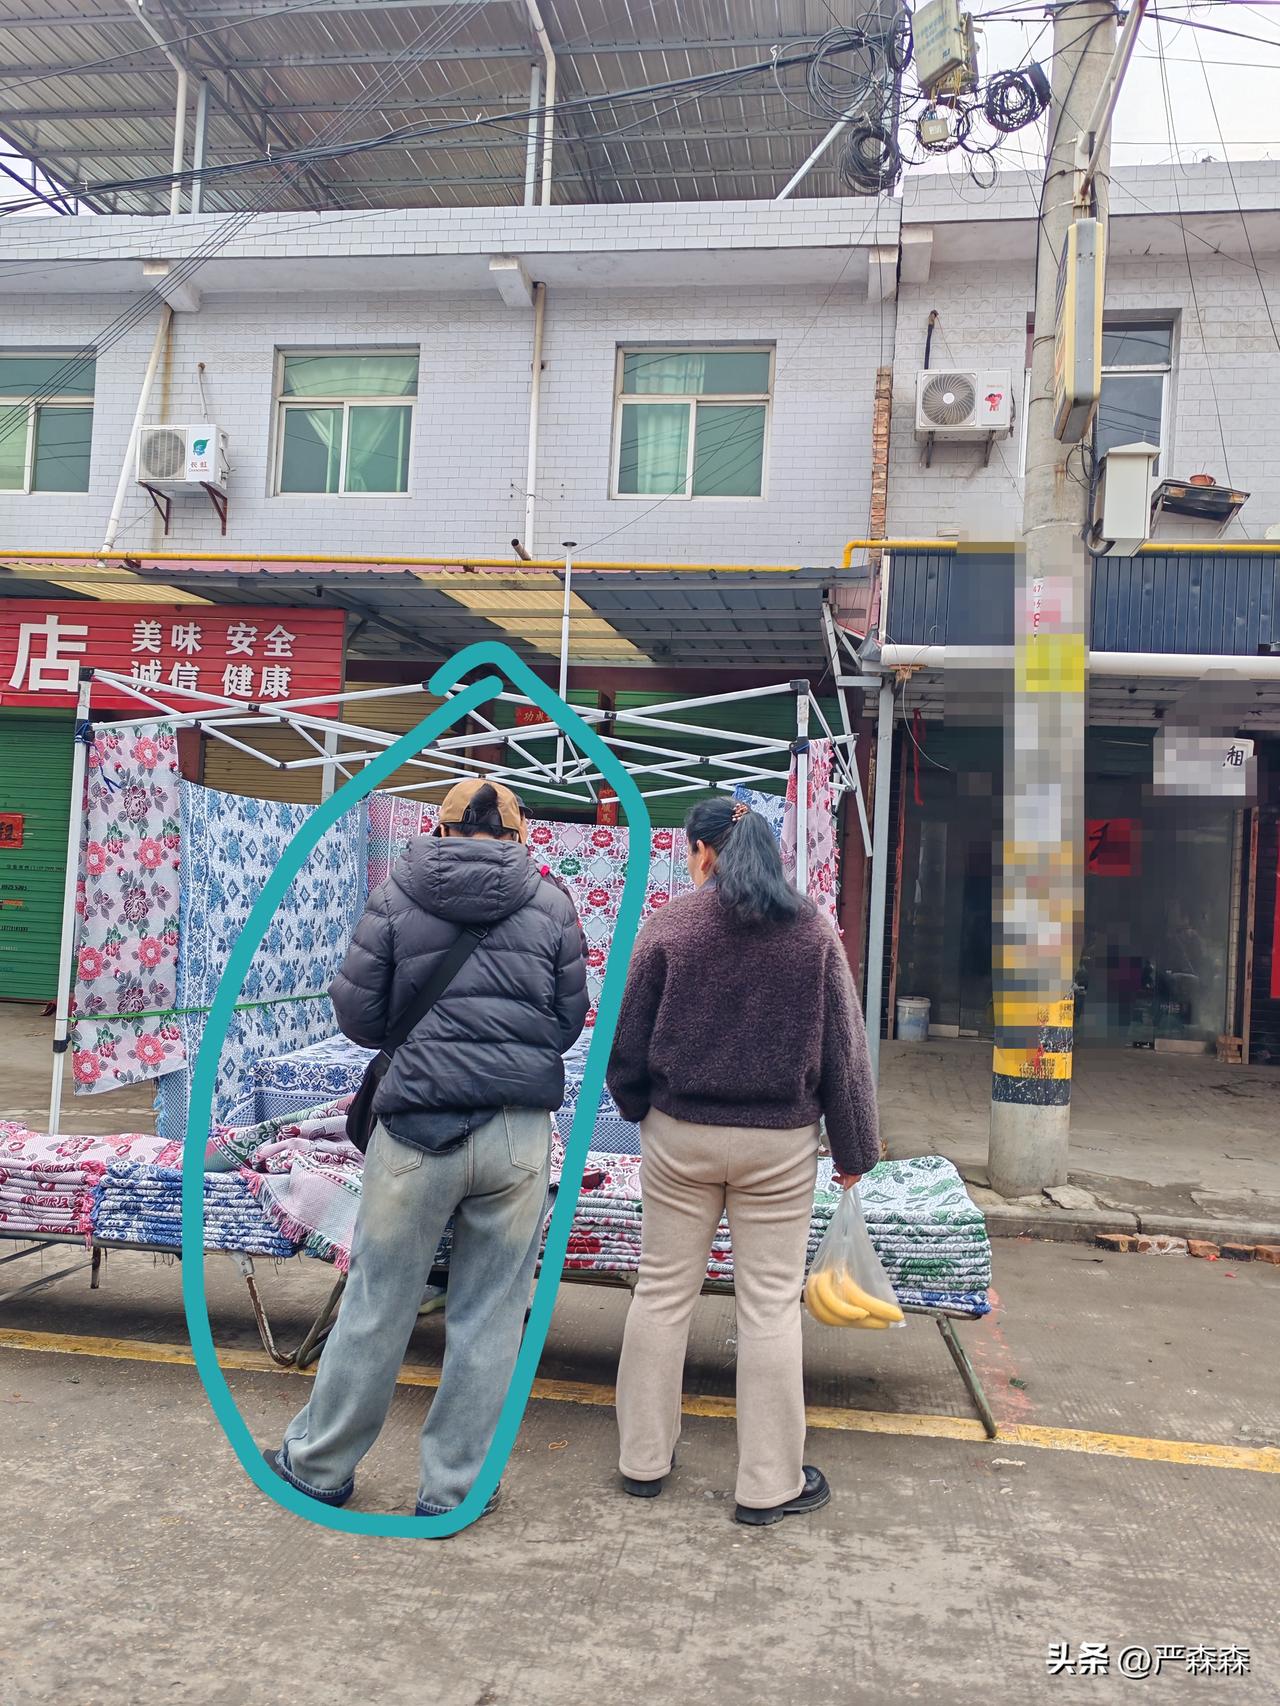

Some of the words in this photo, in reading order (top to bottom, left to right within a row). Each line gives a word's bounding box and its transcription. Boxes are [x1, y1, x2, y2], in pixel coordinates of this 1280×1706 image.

[8, 614, 89, 692] 店
[131, 619, 202, 655] 美味
[225, 622, 296, 658] 安全
[130, 659, 201, 693] 诚信
[221, 663, 292, 699] 健康
